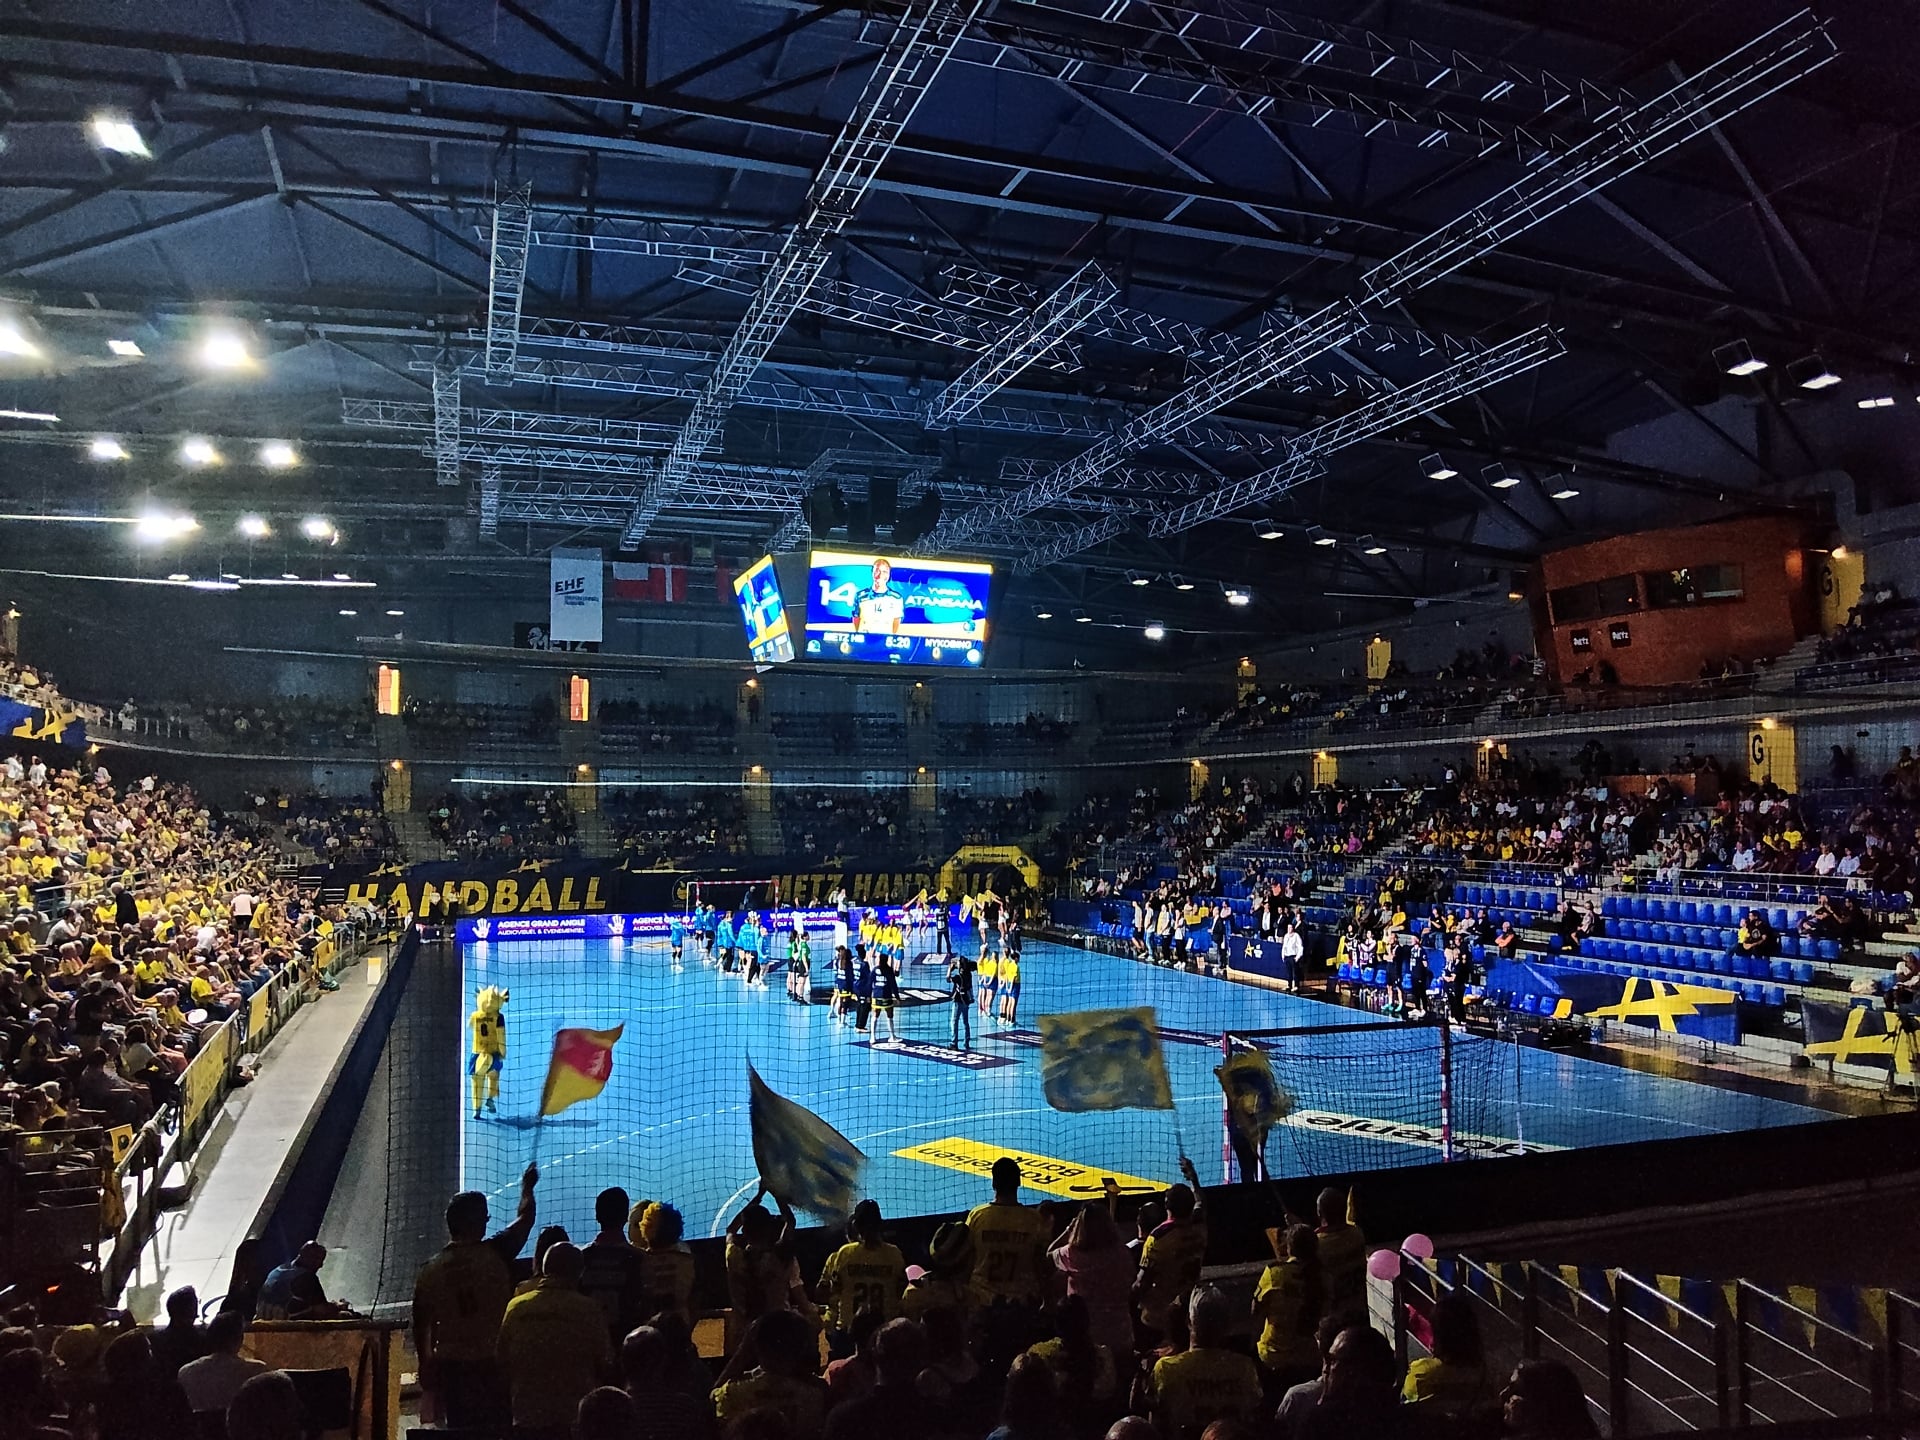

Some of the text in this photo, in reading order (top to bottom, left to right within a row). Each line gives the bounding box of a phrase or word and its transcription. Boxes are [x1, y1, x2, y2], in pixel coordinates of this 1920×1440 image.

[555, 576, 585, 592] EHF
[819, 579, 857, 607] 14
[1821, 566, 1833, 596] G
[1751, 734, 1764, 765] G
[347, 876, 607, 918] HANDBALL
[764, 872, 996, 901] METZ HANDALL
[497, 918, 586, 928] AGENCE GRAND ANGLE
[633, 917, 663, 925] AGENCE
[917, 1147, 1062, 1185] Rafeisen
[988, 1251, 1018, 1282] 27
